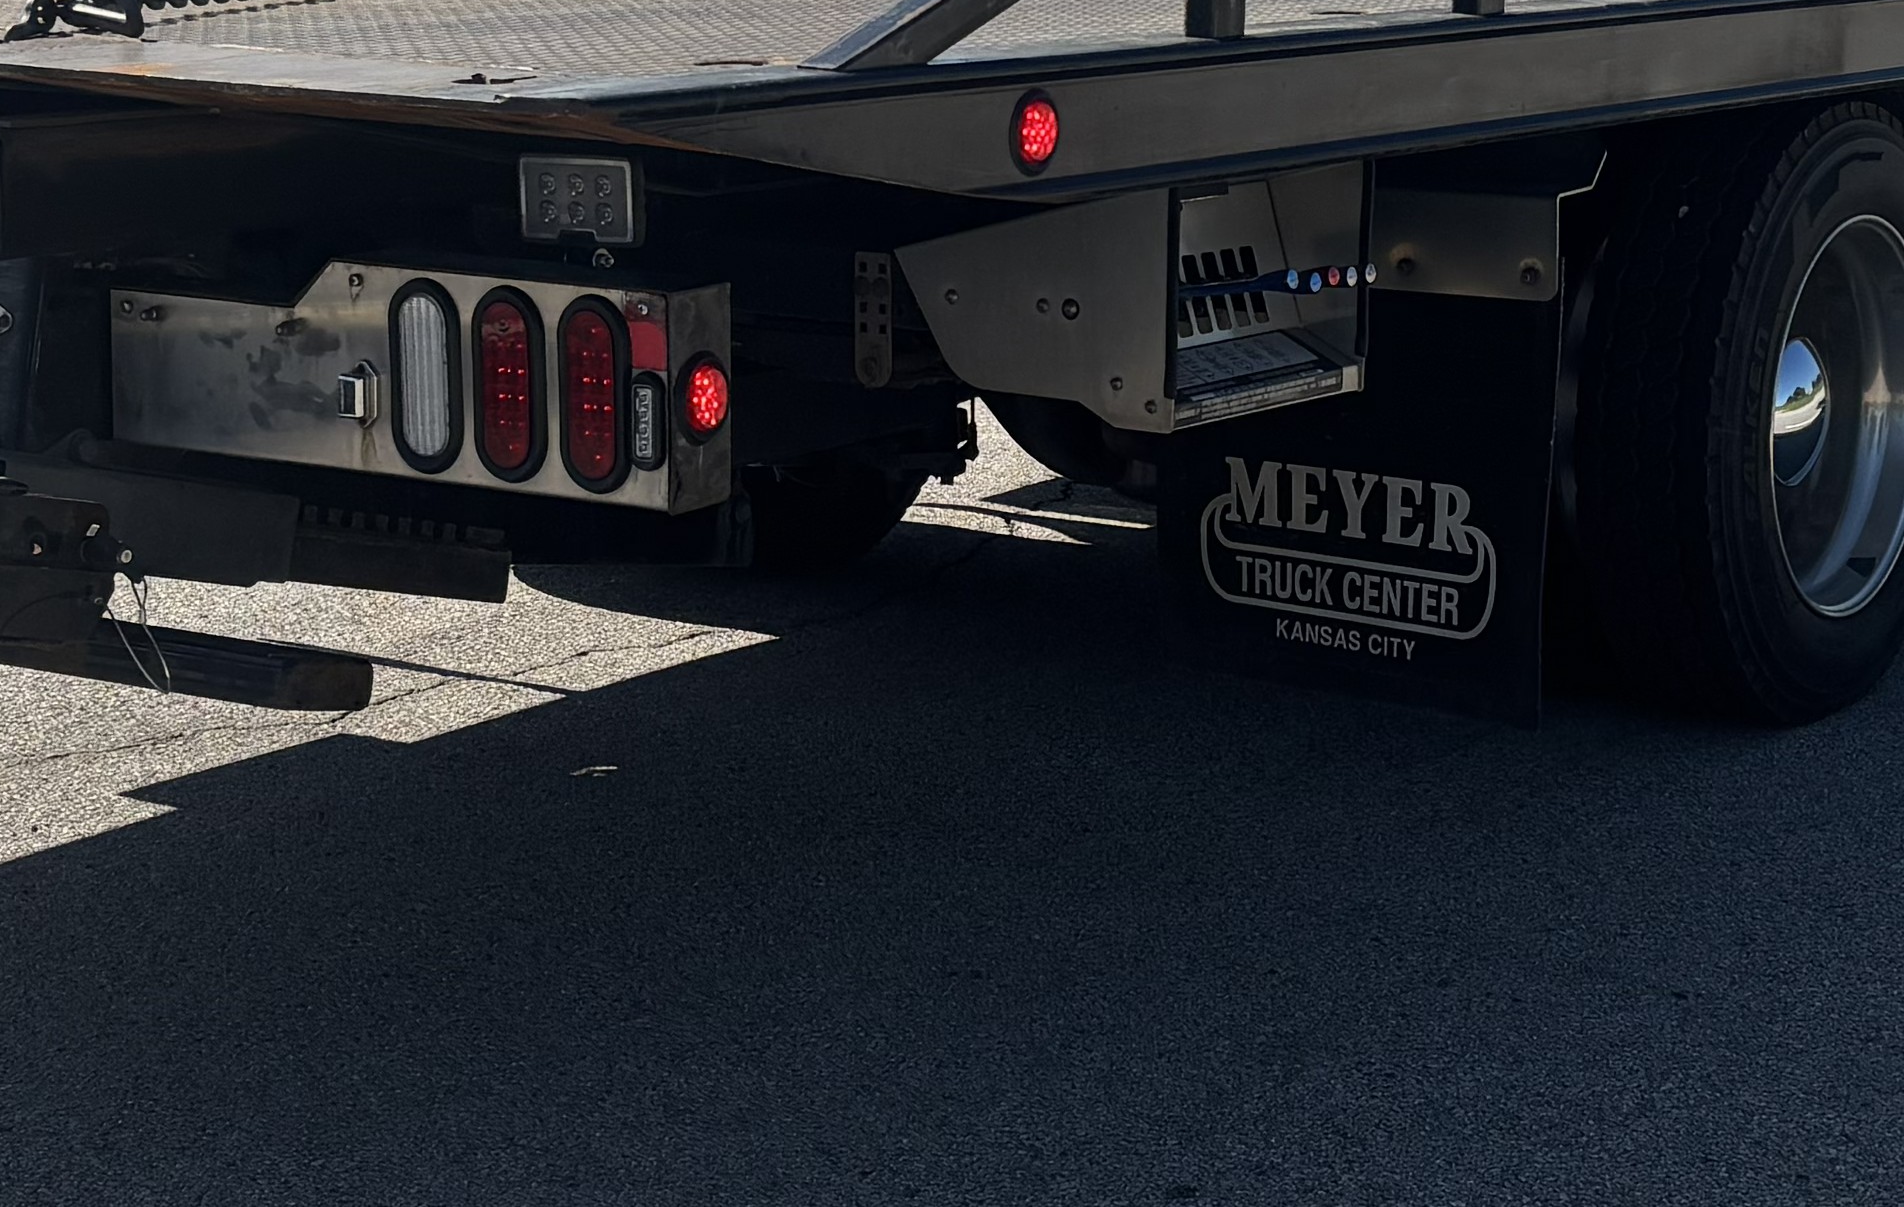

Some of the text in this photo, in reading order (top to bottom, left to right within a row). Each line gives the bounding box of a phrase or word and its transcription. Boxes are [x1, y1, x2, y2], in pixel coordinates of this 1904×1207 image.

[1225, 456, 1474, 555] MEYER
[1235, 555, 1460, 626] TRUCK CENTER
[1276, 618, 1417, 661] KANSAS CITY
